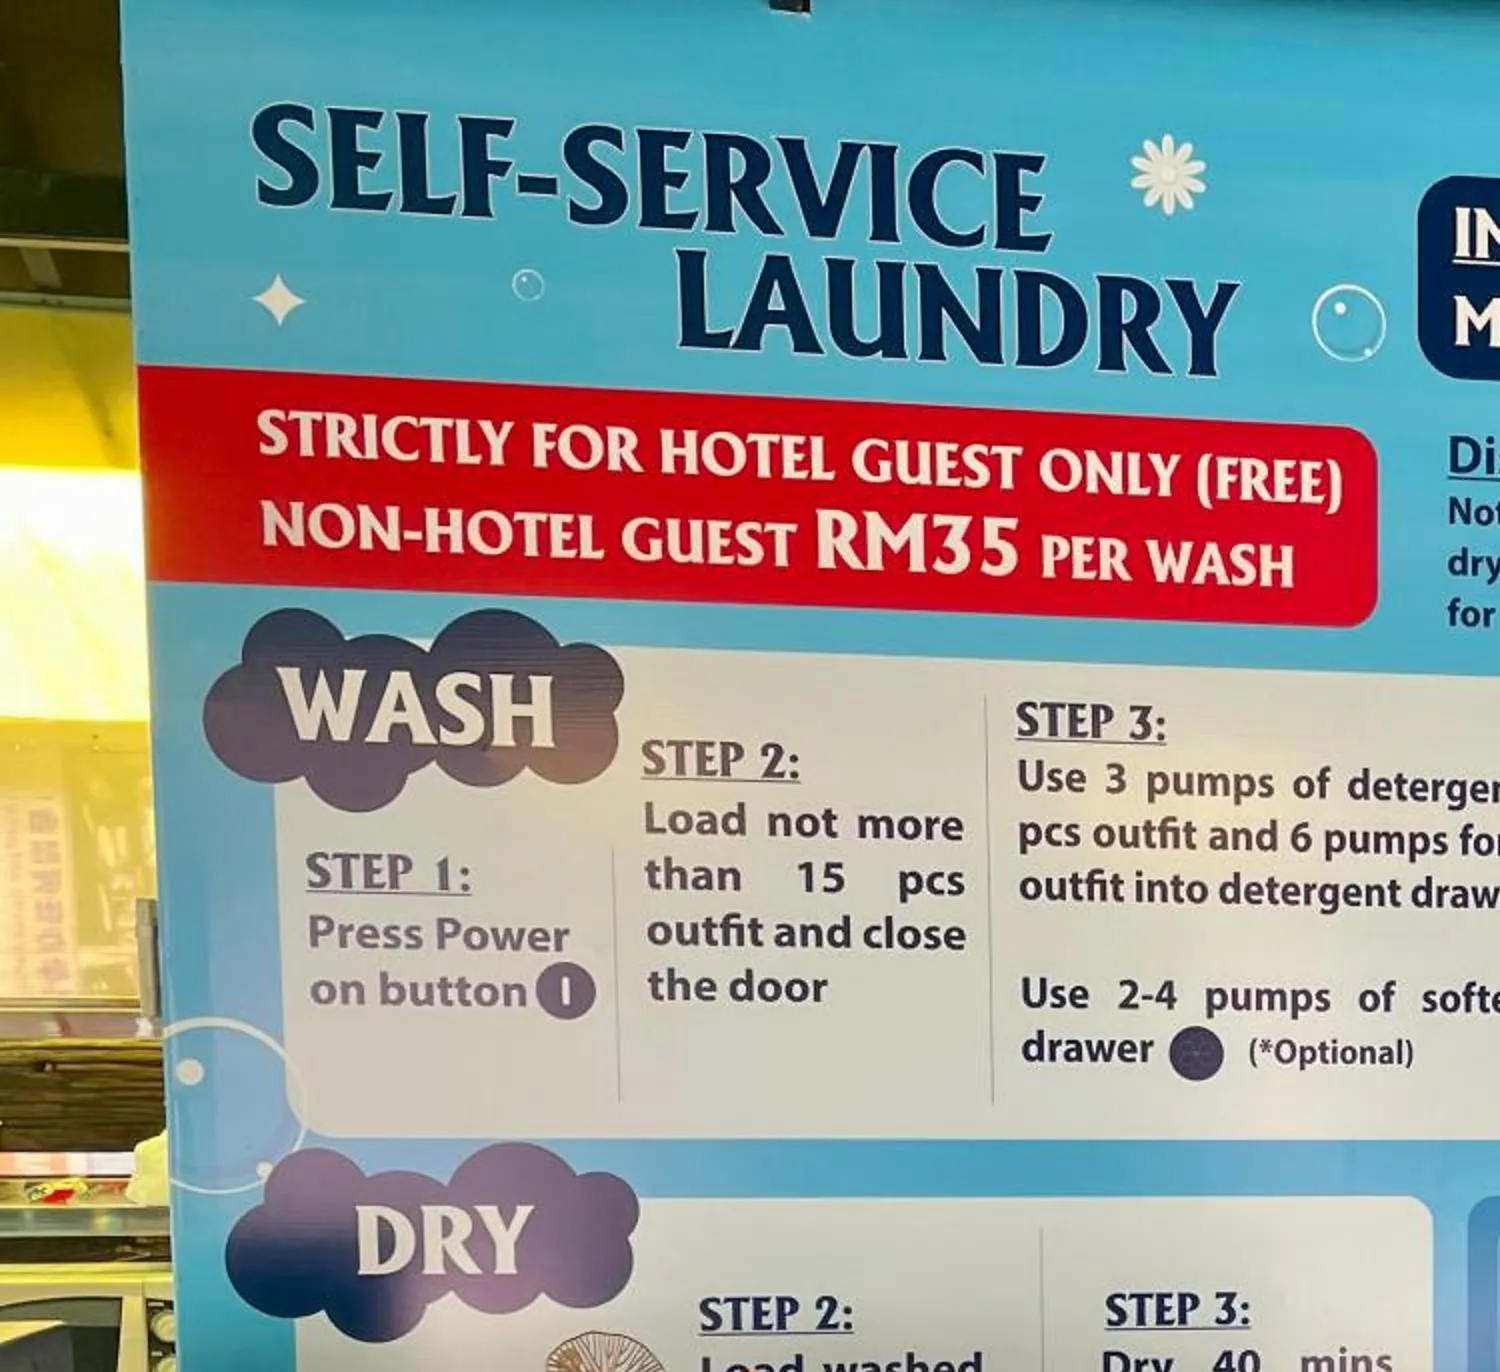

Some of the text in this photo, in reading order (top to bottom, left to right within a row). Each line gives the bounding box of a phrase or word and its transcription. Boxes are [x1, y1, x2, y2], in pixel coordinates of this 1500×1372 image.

[252, 103, 1052, 252] SELF-SERVICE
[676, 249, 1240, 377] LAUNDRY
[257, 409, 1342, 515] STRICTLY FOR HOTEL GUEST ONLY (FREE)
[261, 500, 1294, 588] NON-HOTEL GUEST RM35 PER WASH
[1447, 597, 1497, 628] for
[275, 666, 556, 749] WASH
[1015, 701, 1165, 741] STEP 3:
[641, 739, 800, 780] STEP 2:
[1018, 758, 1087, 793] Use
[1105, 762, 1127, 795] 3
[1147, 771, 1275, 806] pumps
[1293, 765, 1332, 800] of
[645, 801, 964, 841] Load not more
[305, 851, 471, 893] STEP 1:
[644, 855, 965, 904] than 15 pcs
[309, 914, 571, 953] Press Power
[310, 970, 527, 1008] on button
[647, 967, 829, 1003] the door
[1021, 1029, 1155, 1063] drawer
[355, 1204, 535, 1275] DRY
[699, 1295, 853, 1332] STEP 2:
[1105, 1291, 1250, 1327] STEP 3:
